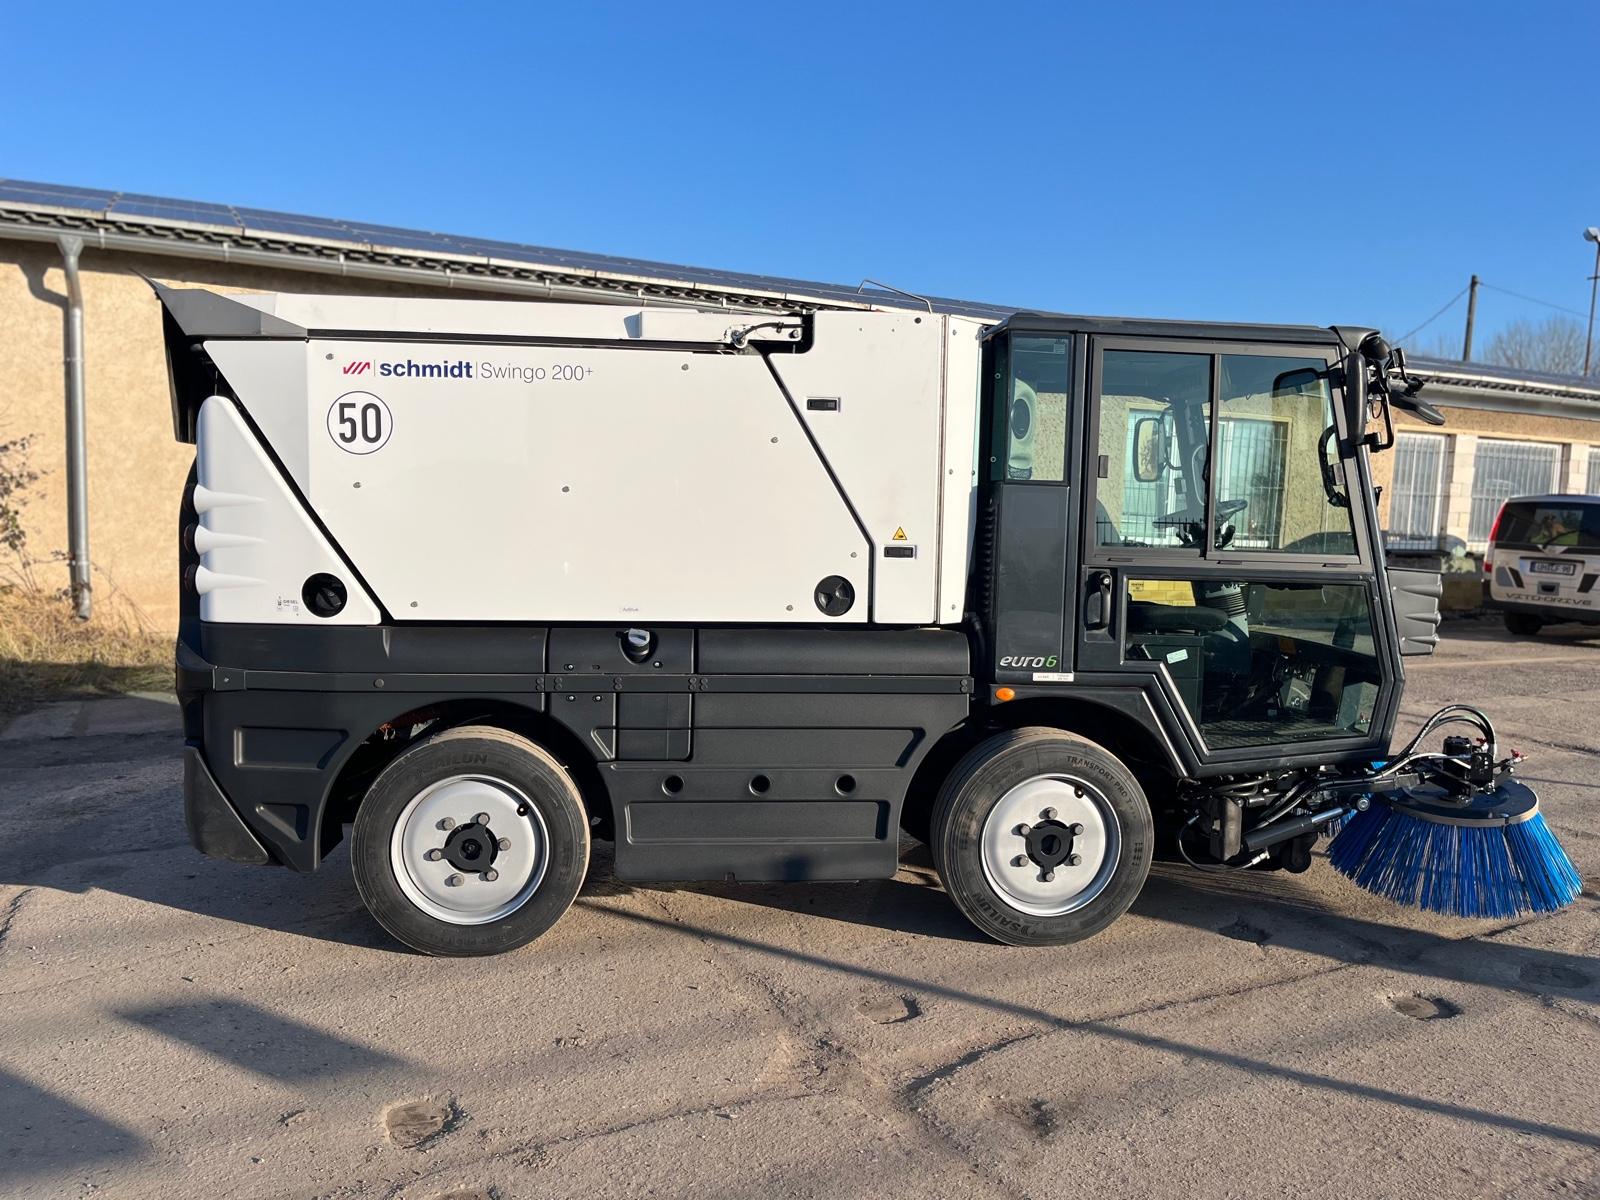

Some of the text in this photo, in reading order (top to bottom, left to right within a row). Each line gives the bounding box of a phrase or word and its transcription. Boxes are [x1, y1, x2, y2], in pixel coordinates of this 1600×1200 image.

[379, 360, 594, 383] schmidt Swingo 200+
[338, 402, 382, 444] 50
[1066, 755, 1115, 783] TRANSPORT
[972, 892, 1021, 931] SAILUN
